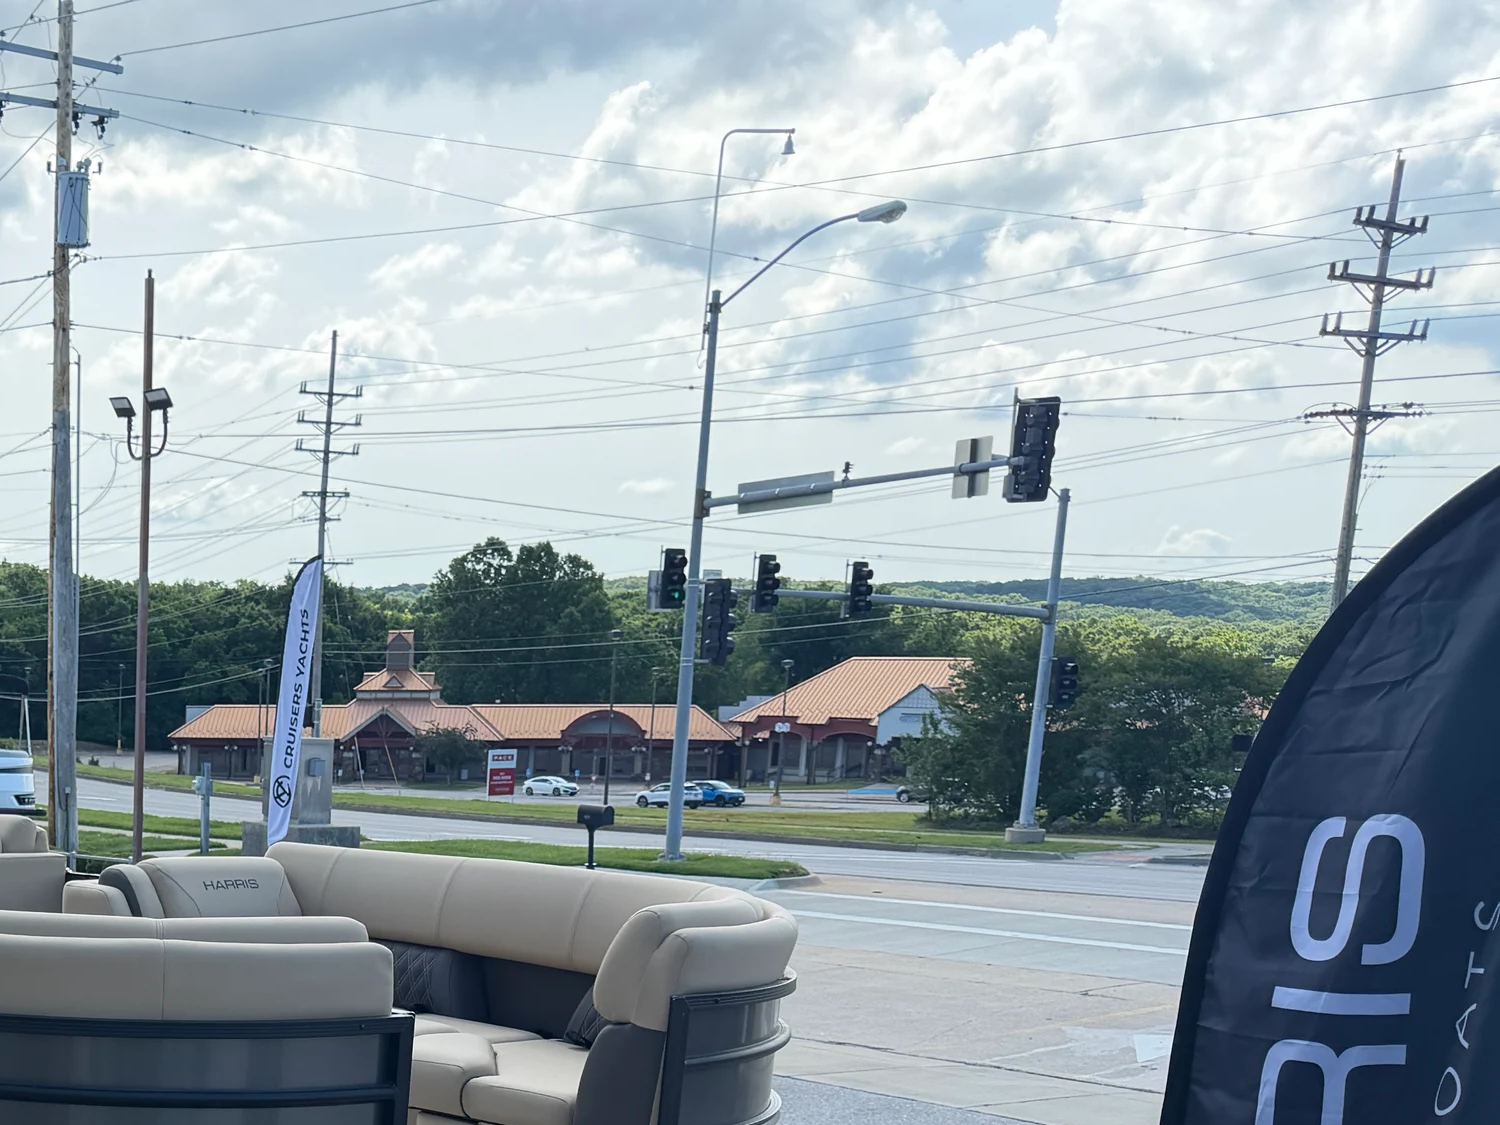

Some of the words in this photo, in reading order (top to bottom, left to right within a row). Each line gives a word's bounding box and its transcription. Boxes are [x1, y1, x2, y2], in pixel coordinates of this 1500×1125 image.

[283, 682, 302, 770] CRUISERS
[295, 608, 310, 678] YACHTS
[202, 878, 260, 891] HARRIS
